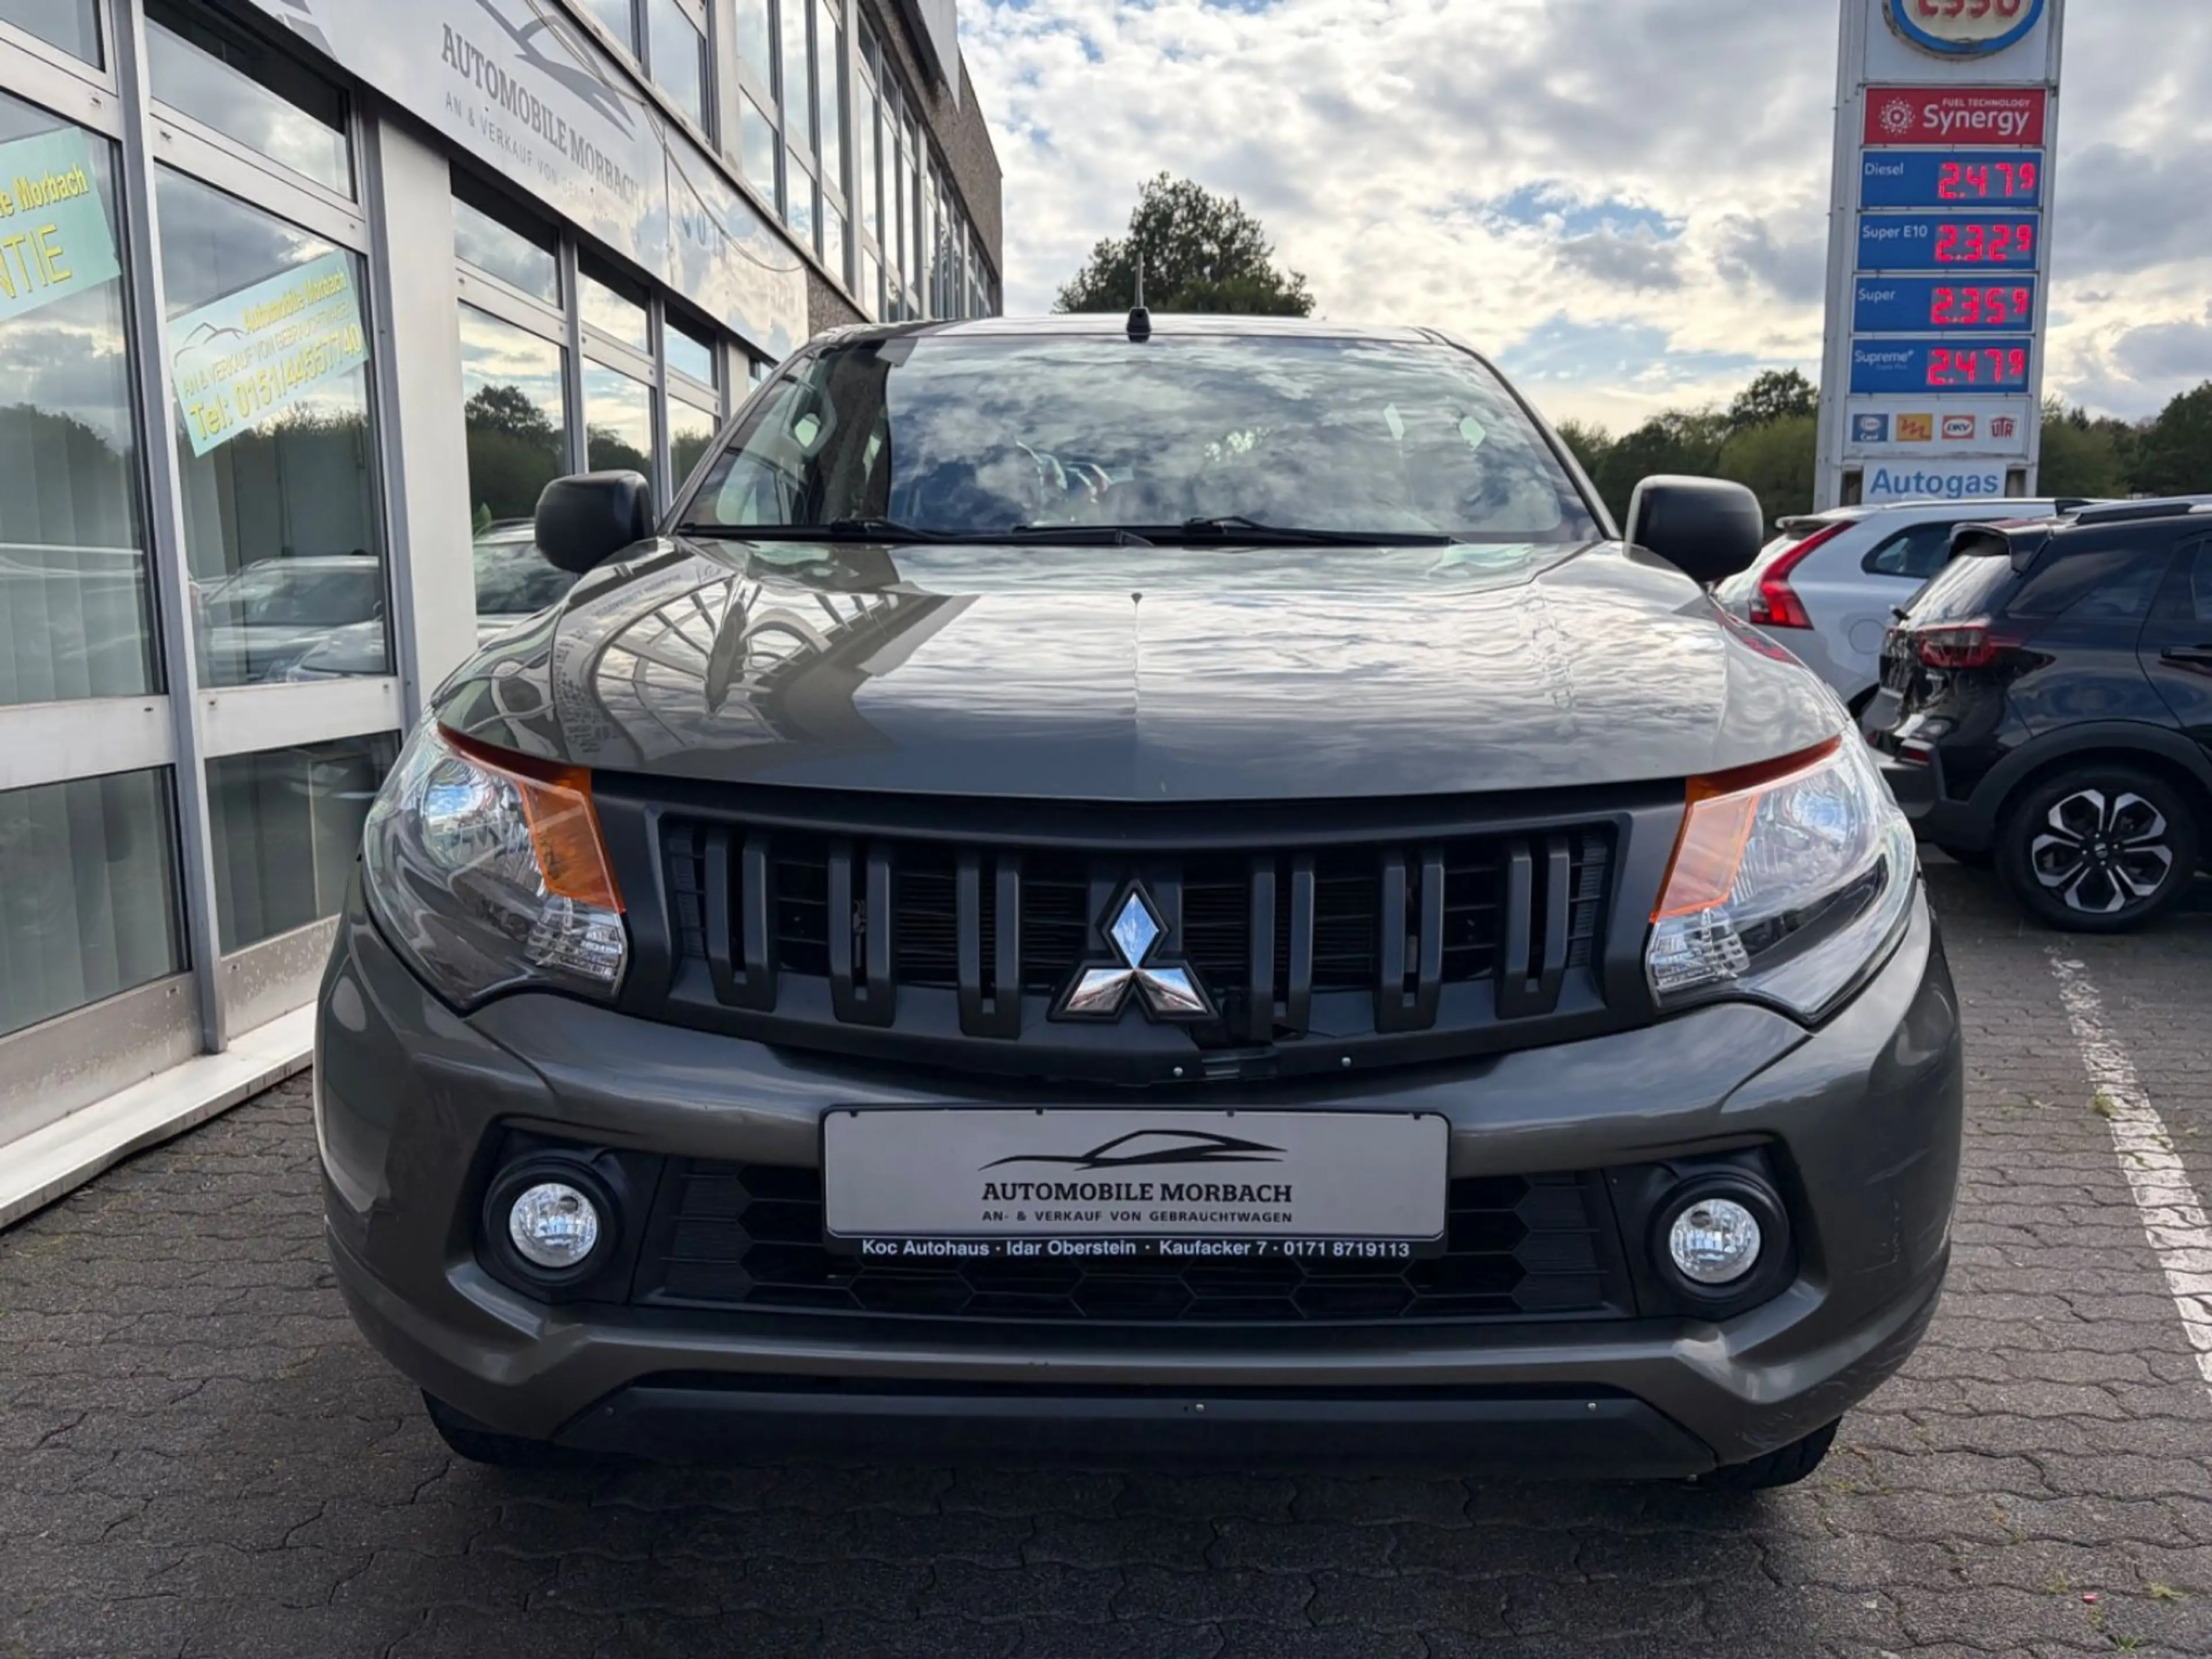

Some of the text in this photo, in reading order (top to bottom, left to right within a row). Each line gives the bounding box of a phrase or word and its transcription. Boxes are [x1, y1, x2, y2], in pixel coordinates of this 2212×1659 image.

[441, 22, 567, 155] AUTOMOBILE
[1942, 98, 2031, 108] FUEL TECHNOLOGY
[1922, 104, 2030, 136] Synergy
[480, 115, 532, 167] VERKAUF
[1865, 162, 1903, 175] Diesel
[13, 162, 89, 212] Morbach
[1862, 226, 1900, 240] Super
[1904, 225, 1927, 237] E10
[1858, 289, 1896, 302] Super
[190, 393, 233, 441] Tel:
[1870, 468, 1998, 499] Autogas
[982, 1183, 1293, 1203] AUTOMOBILE MORBACH
[982, 1211, 1293, 1223] AN- & VERKAUF VON GEBRAUCHTWAGEN
[862, 1239, 1410, 1257] Koc Autohaus Idar Oberstein Kaufacker 7 0171 8719113
